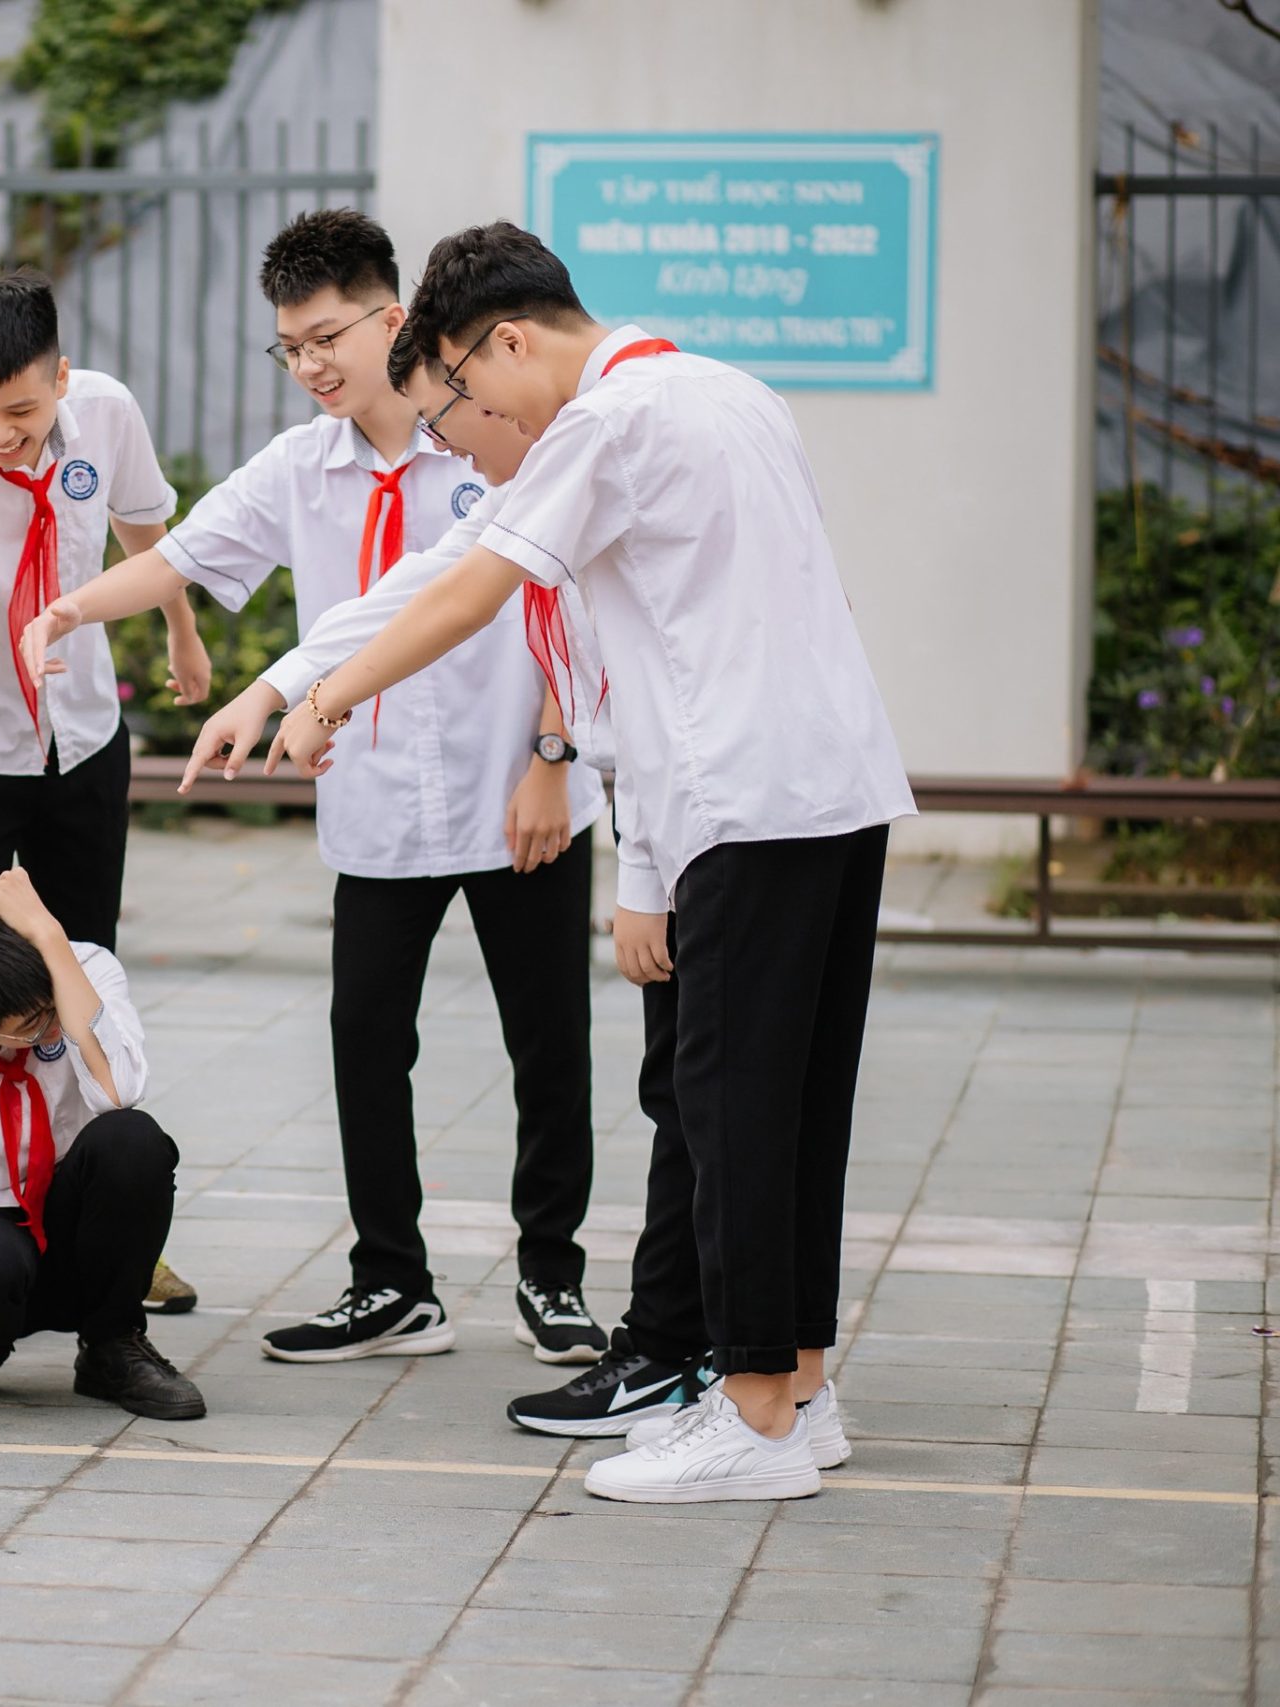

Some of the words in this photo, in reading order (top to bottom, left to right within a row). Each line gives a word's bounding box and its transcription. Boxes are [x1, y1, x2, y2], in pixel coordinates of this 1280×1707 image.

[794, 180, 863, 204] SINH
[579, 218, 643, 253] NIÊN
[647, 217, 719, 255] KHÓA
[810, 223, 880, 256] 2022
[658, 262, 729, 296] Kính
